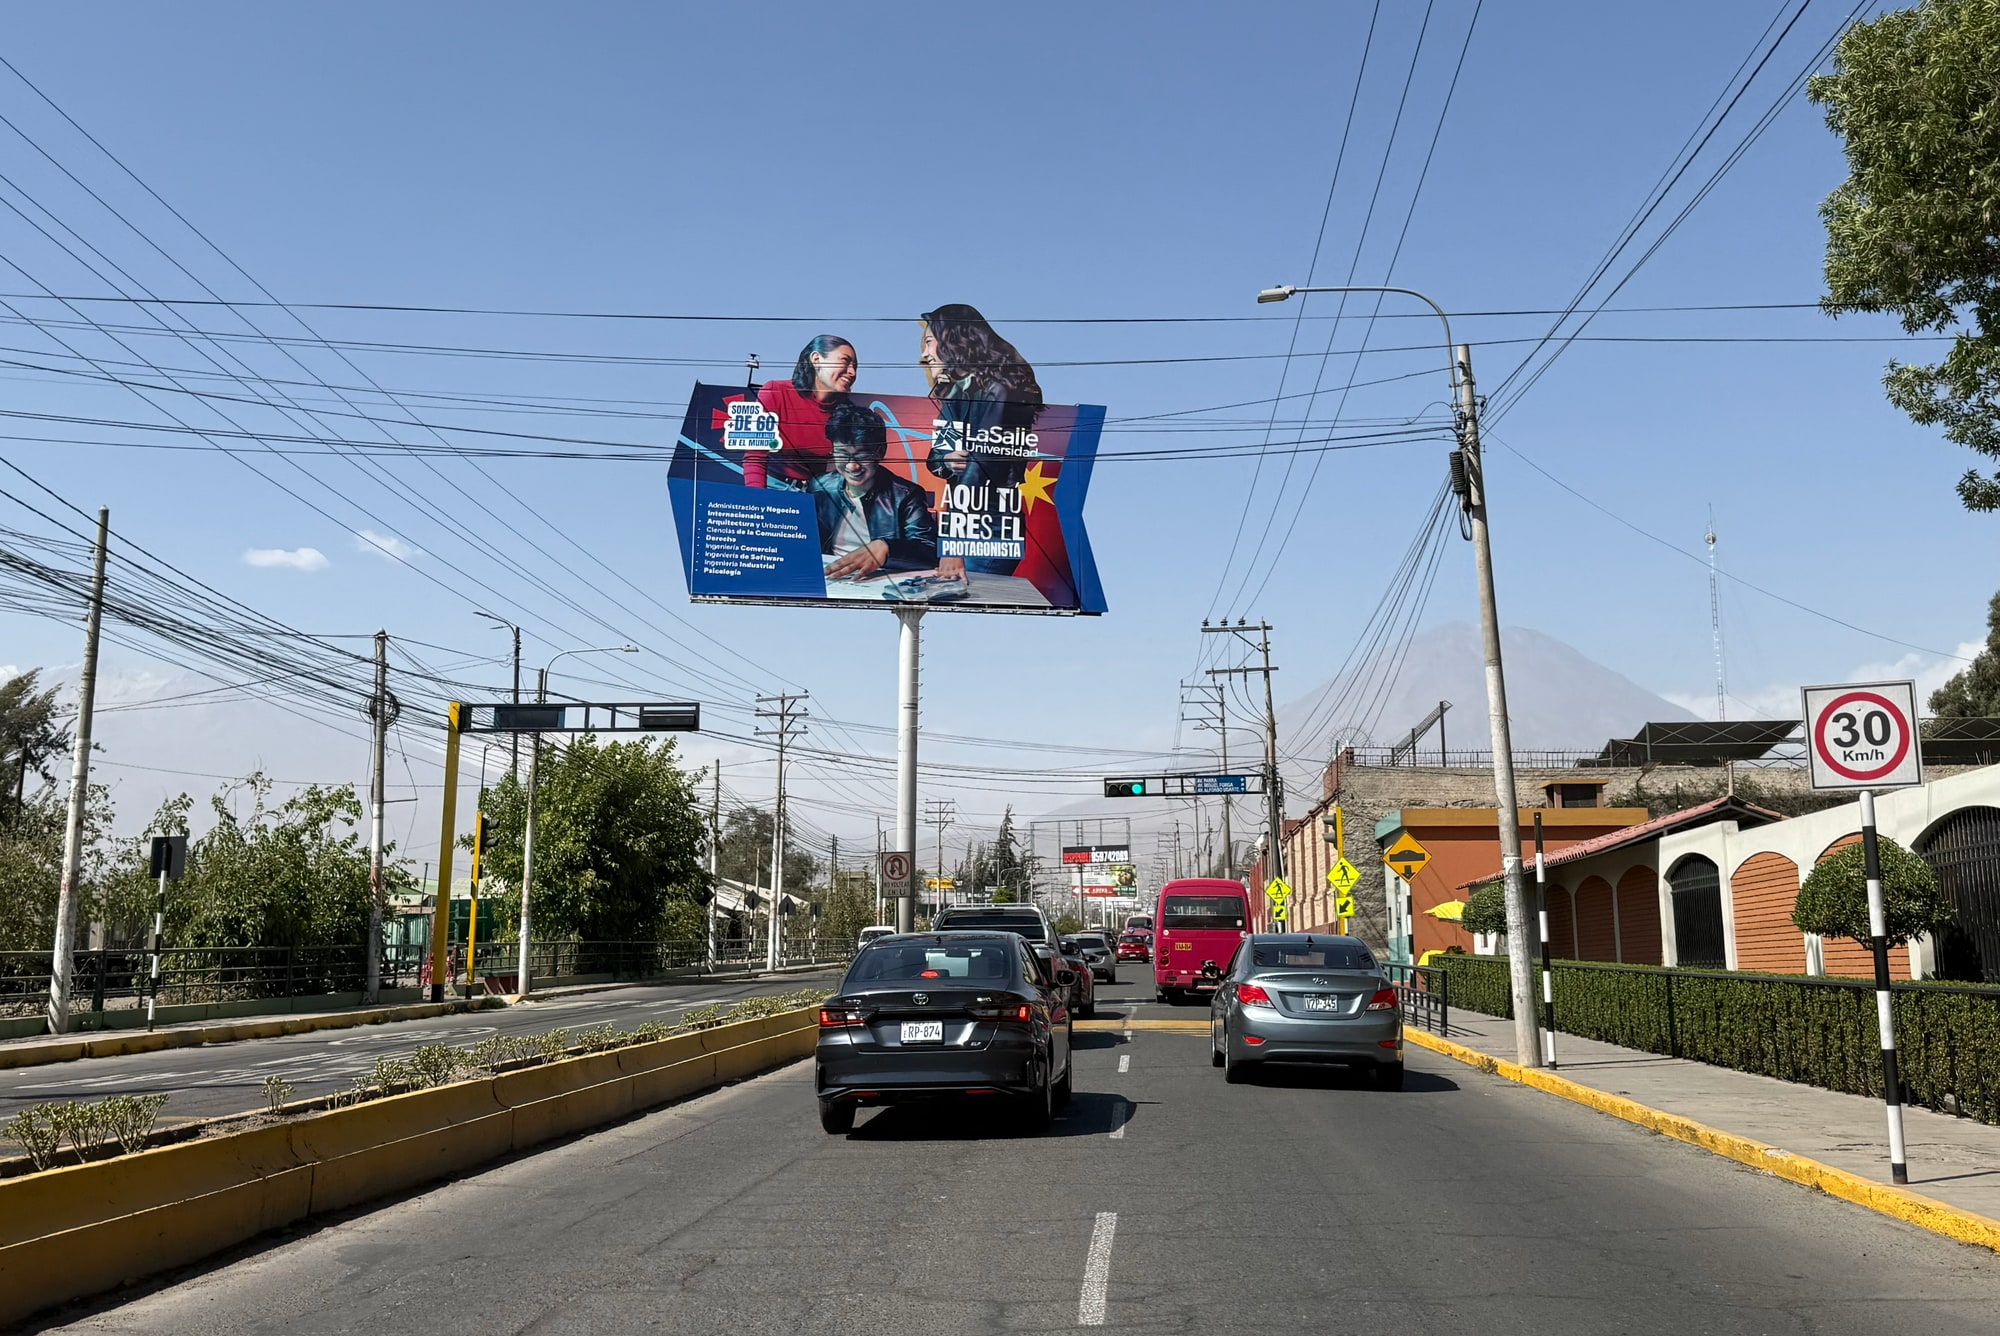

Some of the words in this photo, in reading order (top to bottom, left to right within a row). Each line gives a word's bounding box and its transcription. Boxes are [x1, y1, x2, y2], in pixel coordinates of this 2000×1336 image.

[732, 405, 760, 414] SOMOS
[756, 415, 775, 431] 60
[966, 423, 1038, 447] LaSalle
[966, 441, 1038, 457] Universidad
[940, 480, 990, 512] AQUÍ
[996, 482, 1022, 514] TÚ
[708, 502, 760, 512] Administración
[766, 506, 800, 514] Negocios
[708, 510, 764, 520] Internacionales
[707, 519, 754, 528] Arquitectura
[761, 522, 798, 530] Urbanismo
[938, 512, 992, 540] ERES
[1001, 516, 1024, 540] EL
[755, 530, 807, 539] Comunicación
[705, 543, 739, 551] Ingeniería
[740, 545, 778, 553] Comercial
[942, 540, 1021, 557] PROTAGONISTA
[705, 551, 739, 559] Ingeniería
[704, 559, 738, 568] Ingeniería
[740, 561, 775, 569] Industrial
[704, 568, 741, 576] Psicología
[1832, 710, 1891, 748] 30
[1843, 749, 1884, 762] Km/h
